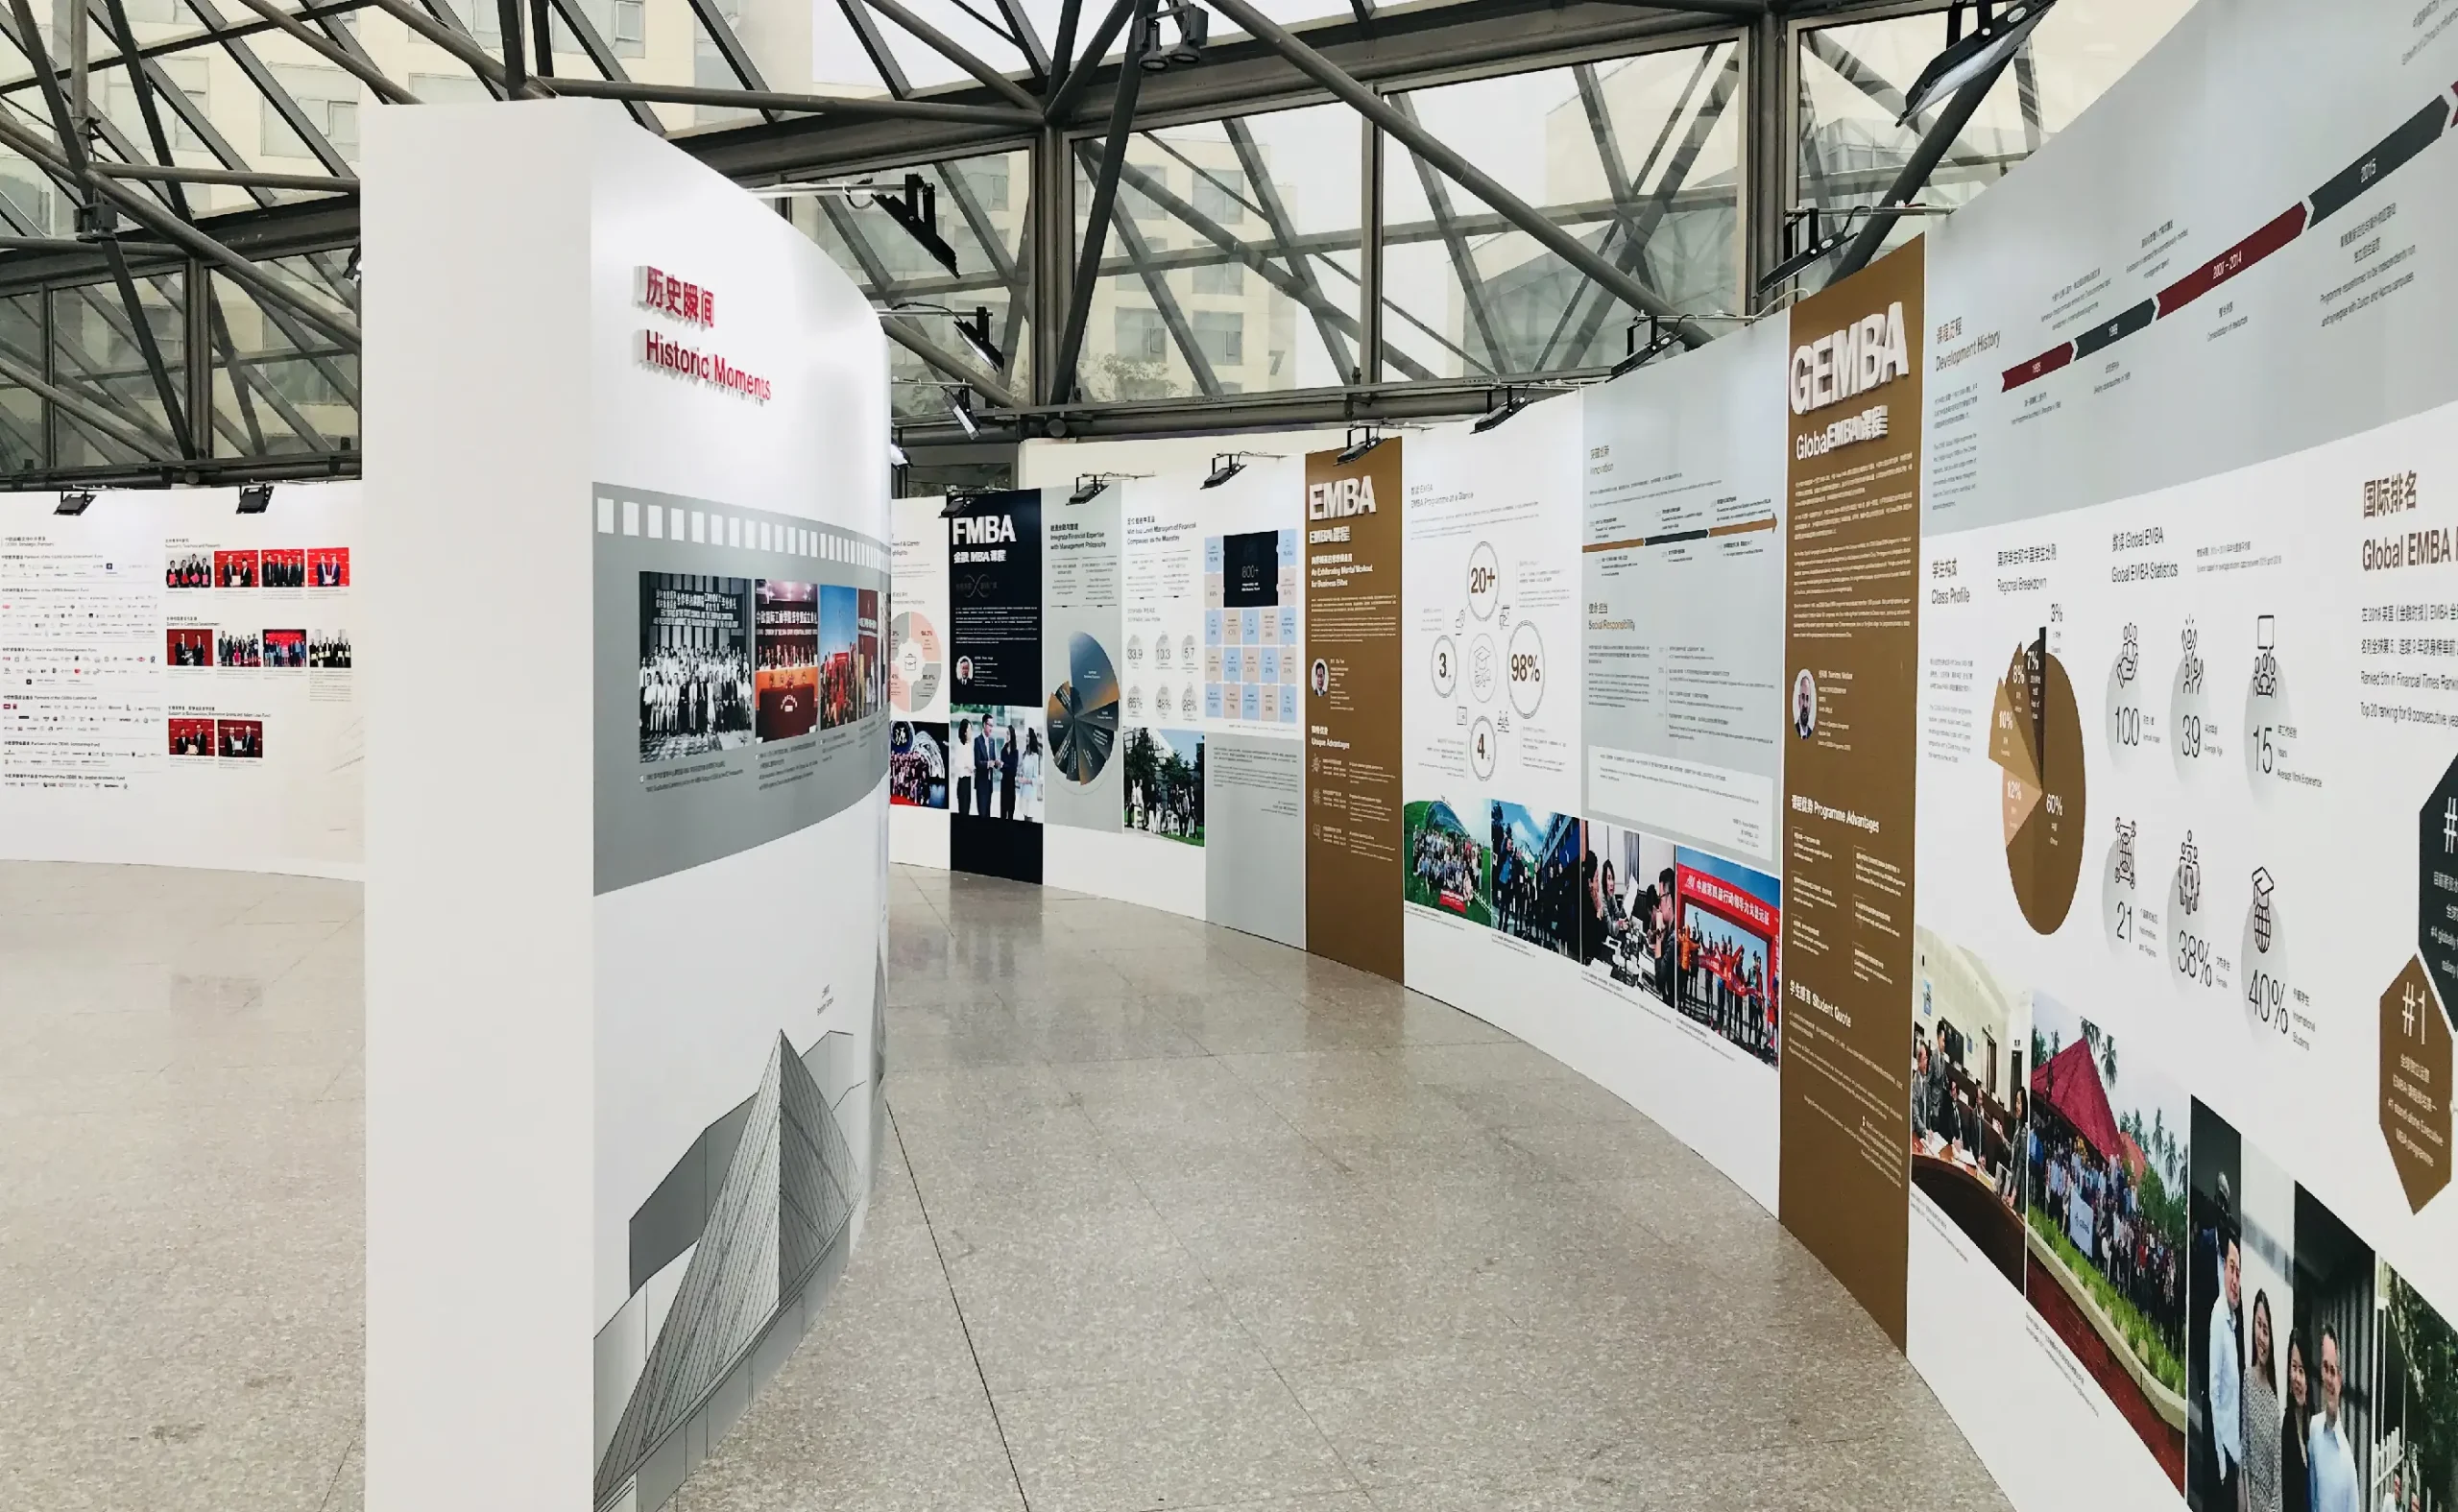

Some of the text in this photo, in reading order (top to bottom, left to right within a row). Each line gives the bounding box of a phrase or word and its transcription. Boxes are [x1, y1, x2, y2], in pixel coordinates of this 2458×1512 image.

[645, 265, 714, 328] 历史瞬间
[645, 329, 772, 400] Historic Moments
[1791, 300, 1909, 415] GEMBA
[1936, 329, 2001, 372] Development History
[1310, 475, 1377, 521] EMBA
[2363, 469, 2418, 519] 国际排名
[952, 515, 1017, 545] FMBA
[970, 550, 990, 563] MBA
[2362, 527, 2451, 572] Global EMBA
[1470, 566, 1496, 593] 20+
[1997, 576, 2047, 596] Regional Breakdown
[2111, 561, 2178, 583] Global EMBA Statistics
[1931, 586, 1970, 605] Class Profile
[1588, 619, 1636, 632] Social Responsibility
[2051, 603, 2062, 623] 3%
[1439, 652, 1447, 678] 3
[1510, 654, 1541, 683] 98%
[2027, 650, 2039, 671] 7%
[2360, 670, 2380, 686] Ranked
[2397, 672, 2422, 689] Financial
[2422, 672, 2440, 690] Times
[1999, 709, 2013, 731] 10%
[2114, 706, 2140, 747] 100
[2360, 702, 2371, 719] Top
[2371, 703, 2378, 718] 20
[2378, 705, 2398, 723] ranking
[2398, 705, 2407, 720] for
[2412, 708, 2447, 727] consecutive
[1326, 737, 1350, 750] Advantages
[1477, 732, 1485, 760] 4
[2181, 714, 2201, 758] 39
[2253, 724, 2273, 774] 15
[2007, 780, 2022, 801] 12%
[2046, 793, 2063, 817] 60%
[1814, 800, 1845, 824] Programme
[1845, 808, 1880, 834] Advantages
[2116, 900, 2133, 943] 21
[2178, 929, 2212, 987] 38%
[1812, 993, 1834, 1018] Student
[1834, 1006, 1852, 1028] Quote
[2248, 968, 2289, 1035] 40%
[2401, 981, 2425, 1045] #1
